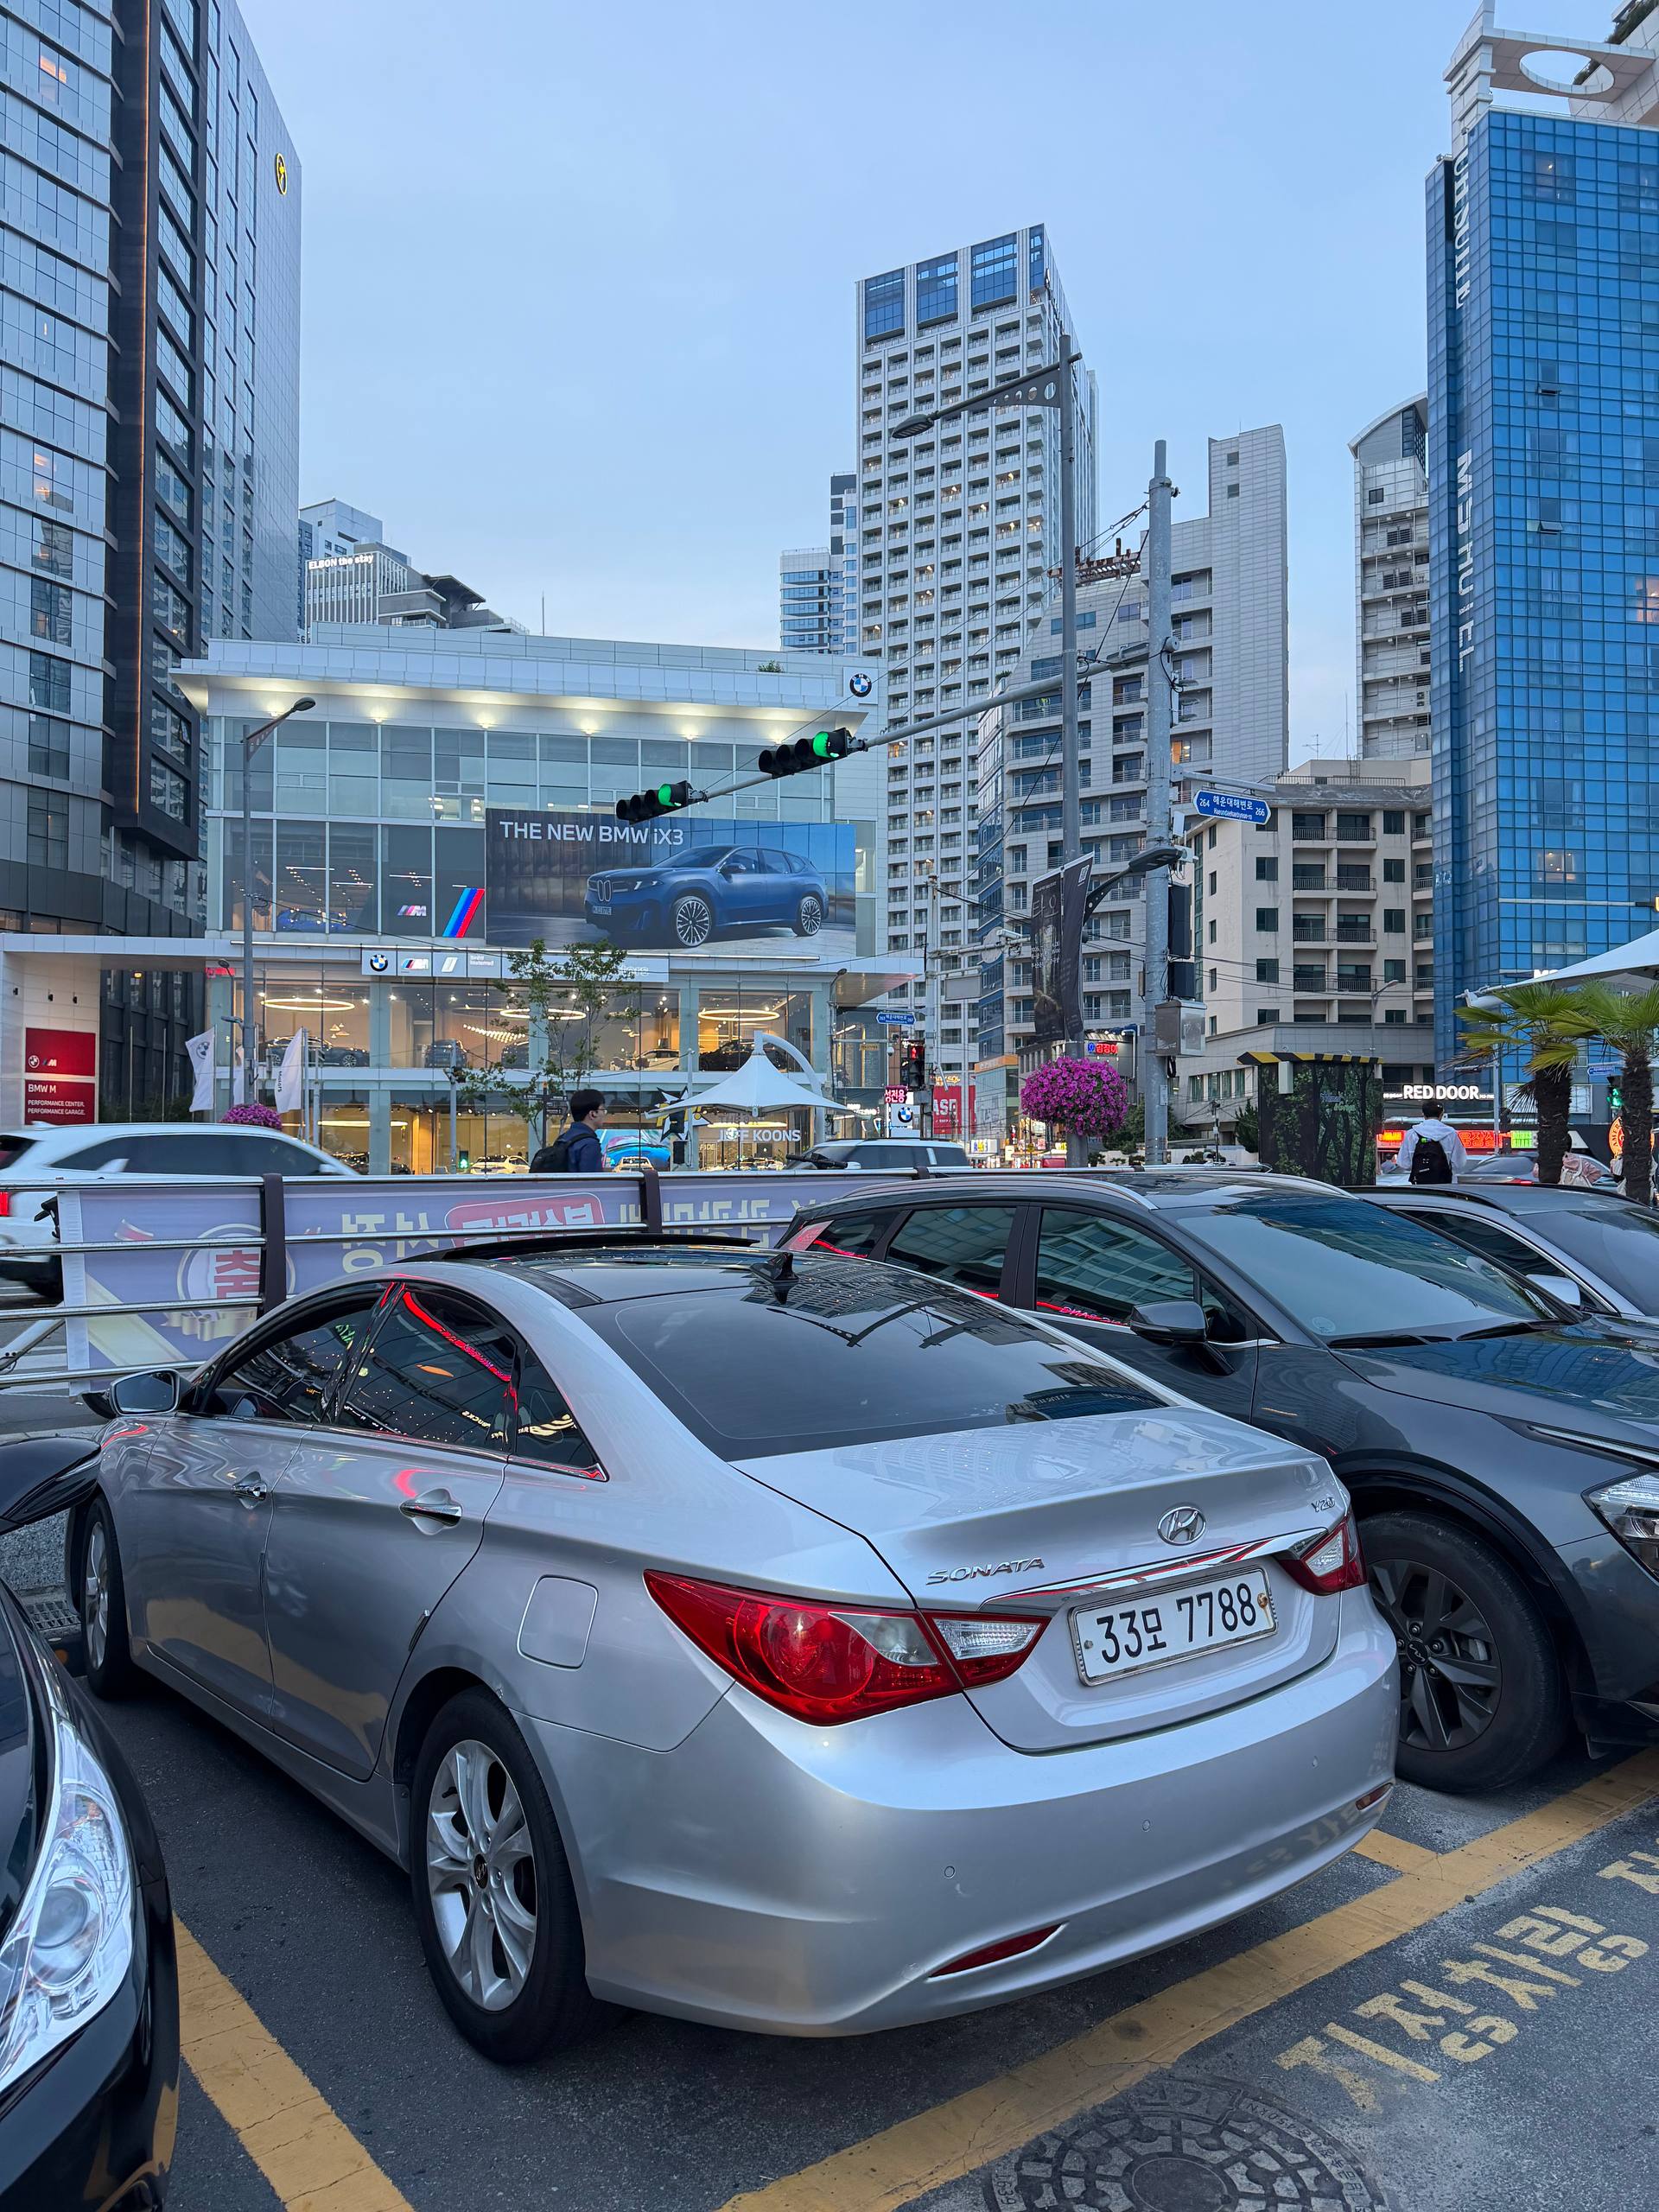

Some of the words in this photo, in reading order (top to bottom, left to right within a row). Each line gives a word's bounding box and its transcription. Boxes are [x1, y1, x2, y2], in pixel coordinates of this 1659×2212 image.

[308, 557, 337, 570] ELBON
[338, 556, 353, 566] the
[354, 554, 374, 564] stay
[1199, 798, 1211, 808] 264
[1212, 795, 1254, 810] 해운대해변로
[1255, 807, 1266, 817] 266
[499, 821, 542, 840] THE
[547, 823, 594, 842] NEW
[599, 825, 649, 844] BMW
[653, 828, 684, 846] iX3
[28, 1084, 48, 1093] BMW
[49, 1084, 57, 1094] M
[1402, 1084, 1434, 1100] RED
[1435, 1085, 1479, 1100] DOOR
[753, 1129, 802, 1143] KOONS
[925, 1556, 1046, 1586] SONATA
[1096, 1606, 1167, 1664] 33모
[1175, 1582, 1257, 1643] 7788
